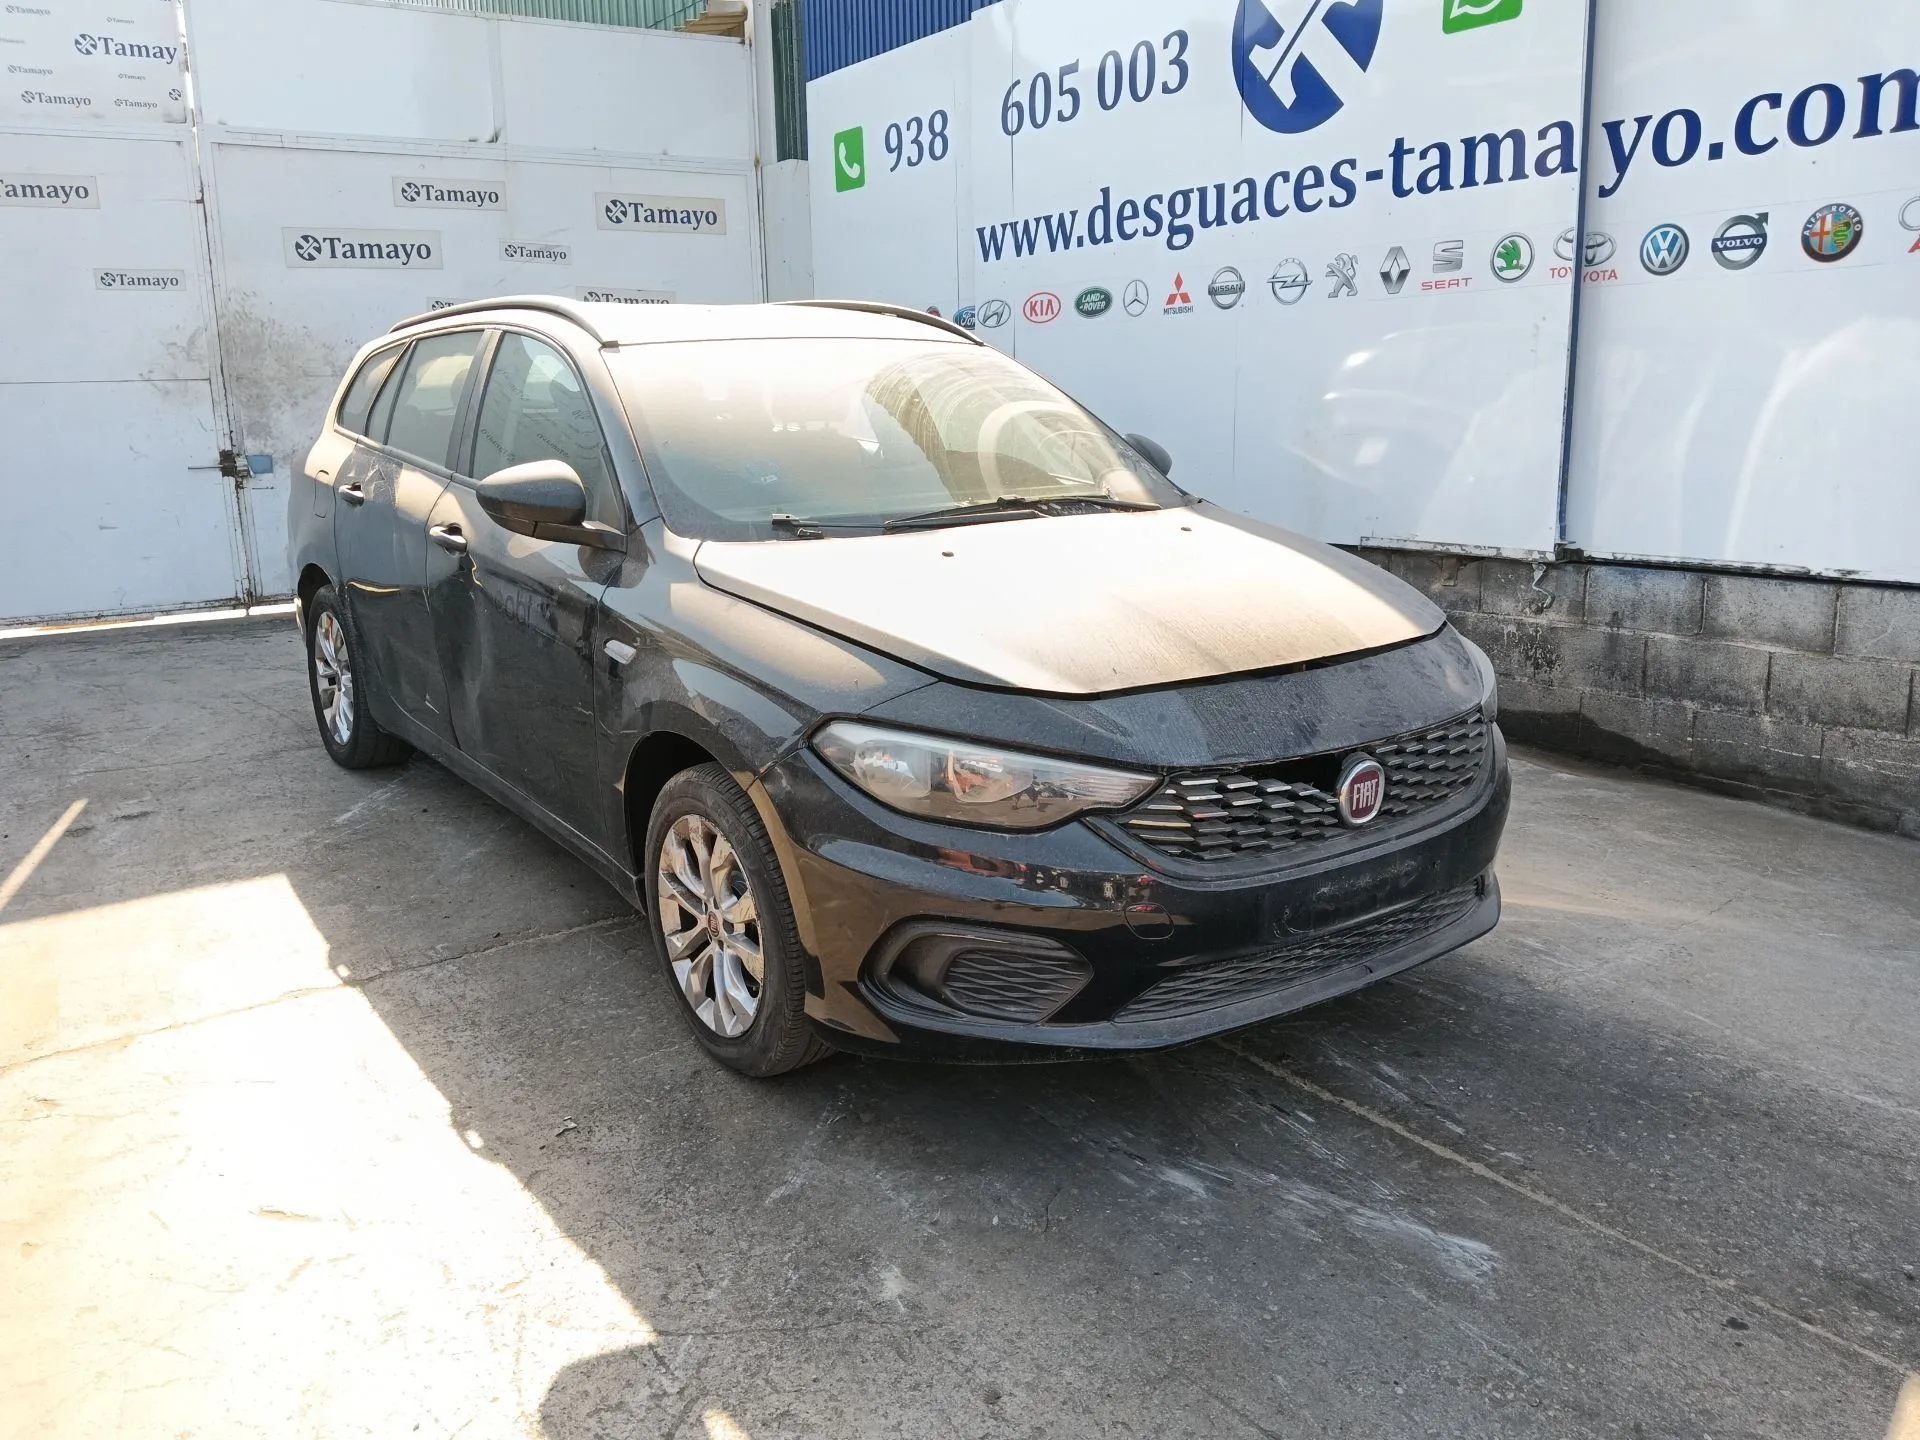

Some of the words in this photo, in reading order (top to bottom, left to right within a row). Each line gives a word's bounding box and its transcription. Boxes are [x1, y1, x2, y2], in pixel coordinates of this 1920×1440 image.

[98, 37, 177, 64] Tamay
[16, 65, 53, 76] Tamayo
[34, 92, 92, 108] Tamayo
[123, 99, 158, 109] Tamayo
[885, 110, 949, 172] 938
[1001, 59, 1081, 136] 605
[1097, 29, 1189, 111] 003
[420, 184, 499, 207] Tamayo
[628, 202, 718, 230] Tamayo
[1803, 211, 1822, 236] ALFA
[1831, 205, 1861, 232] ROMEO
[322, 237, 432, 265] Tamayo
[1715, 237, 1763, 249] VOLVO
[517, 246, 567, 261] Tamayo
[115, 273, 179, 289] Tamayo
[1210, 283, 1242, 294] NISSAN
[1421, 277, 1473, 291] SEAT
[1030, 299, 1055, 317] KIA
[1163, 305, 1194, 316] MITSUBISHI
[1352, 779, 1378, 811] FIAT
